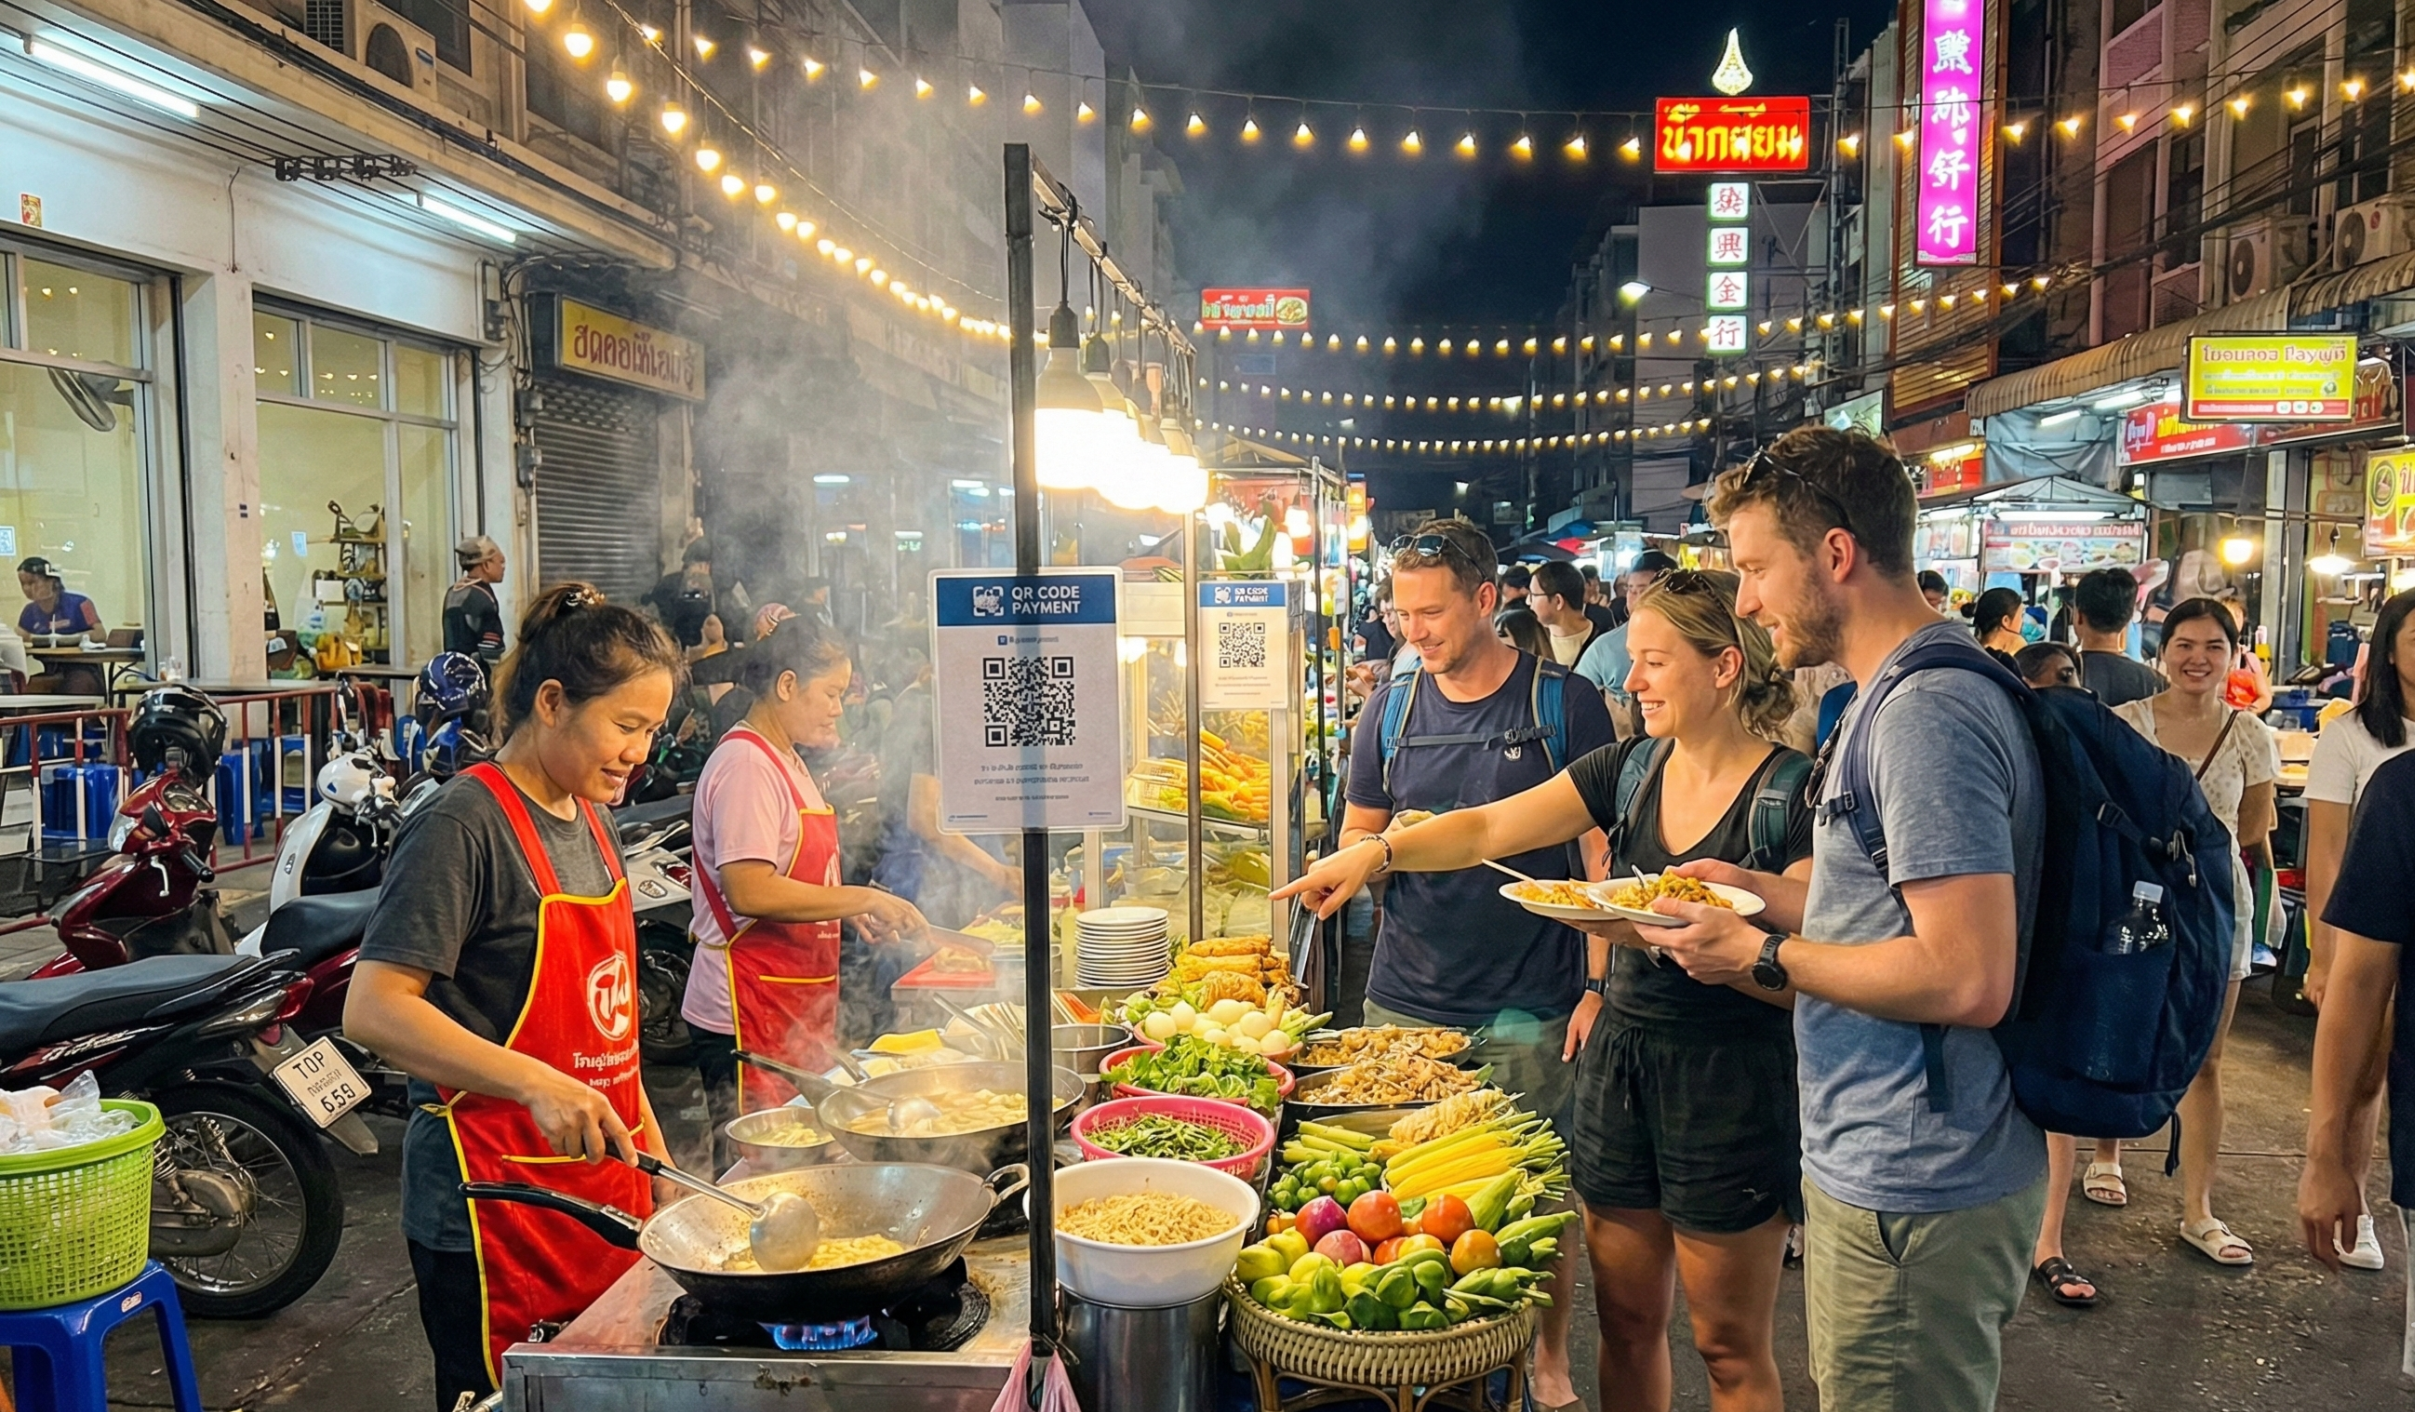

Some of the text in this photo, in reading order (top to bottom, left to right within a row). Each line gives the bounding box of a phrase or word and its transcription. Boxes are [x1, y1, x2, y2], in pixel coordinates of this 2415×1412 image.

[1012, 586, 1080, 601] QR CODE
[1012, 600, 1081, 614] PAYMENT
[292, 1051, 325, 1079] TOP
[321, 1083, 356, 1113] 659
